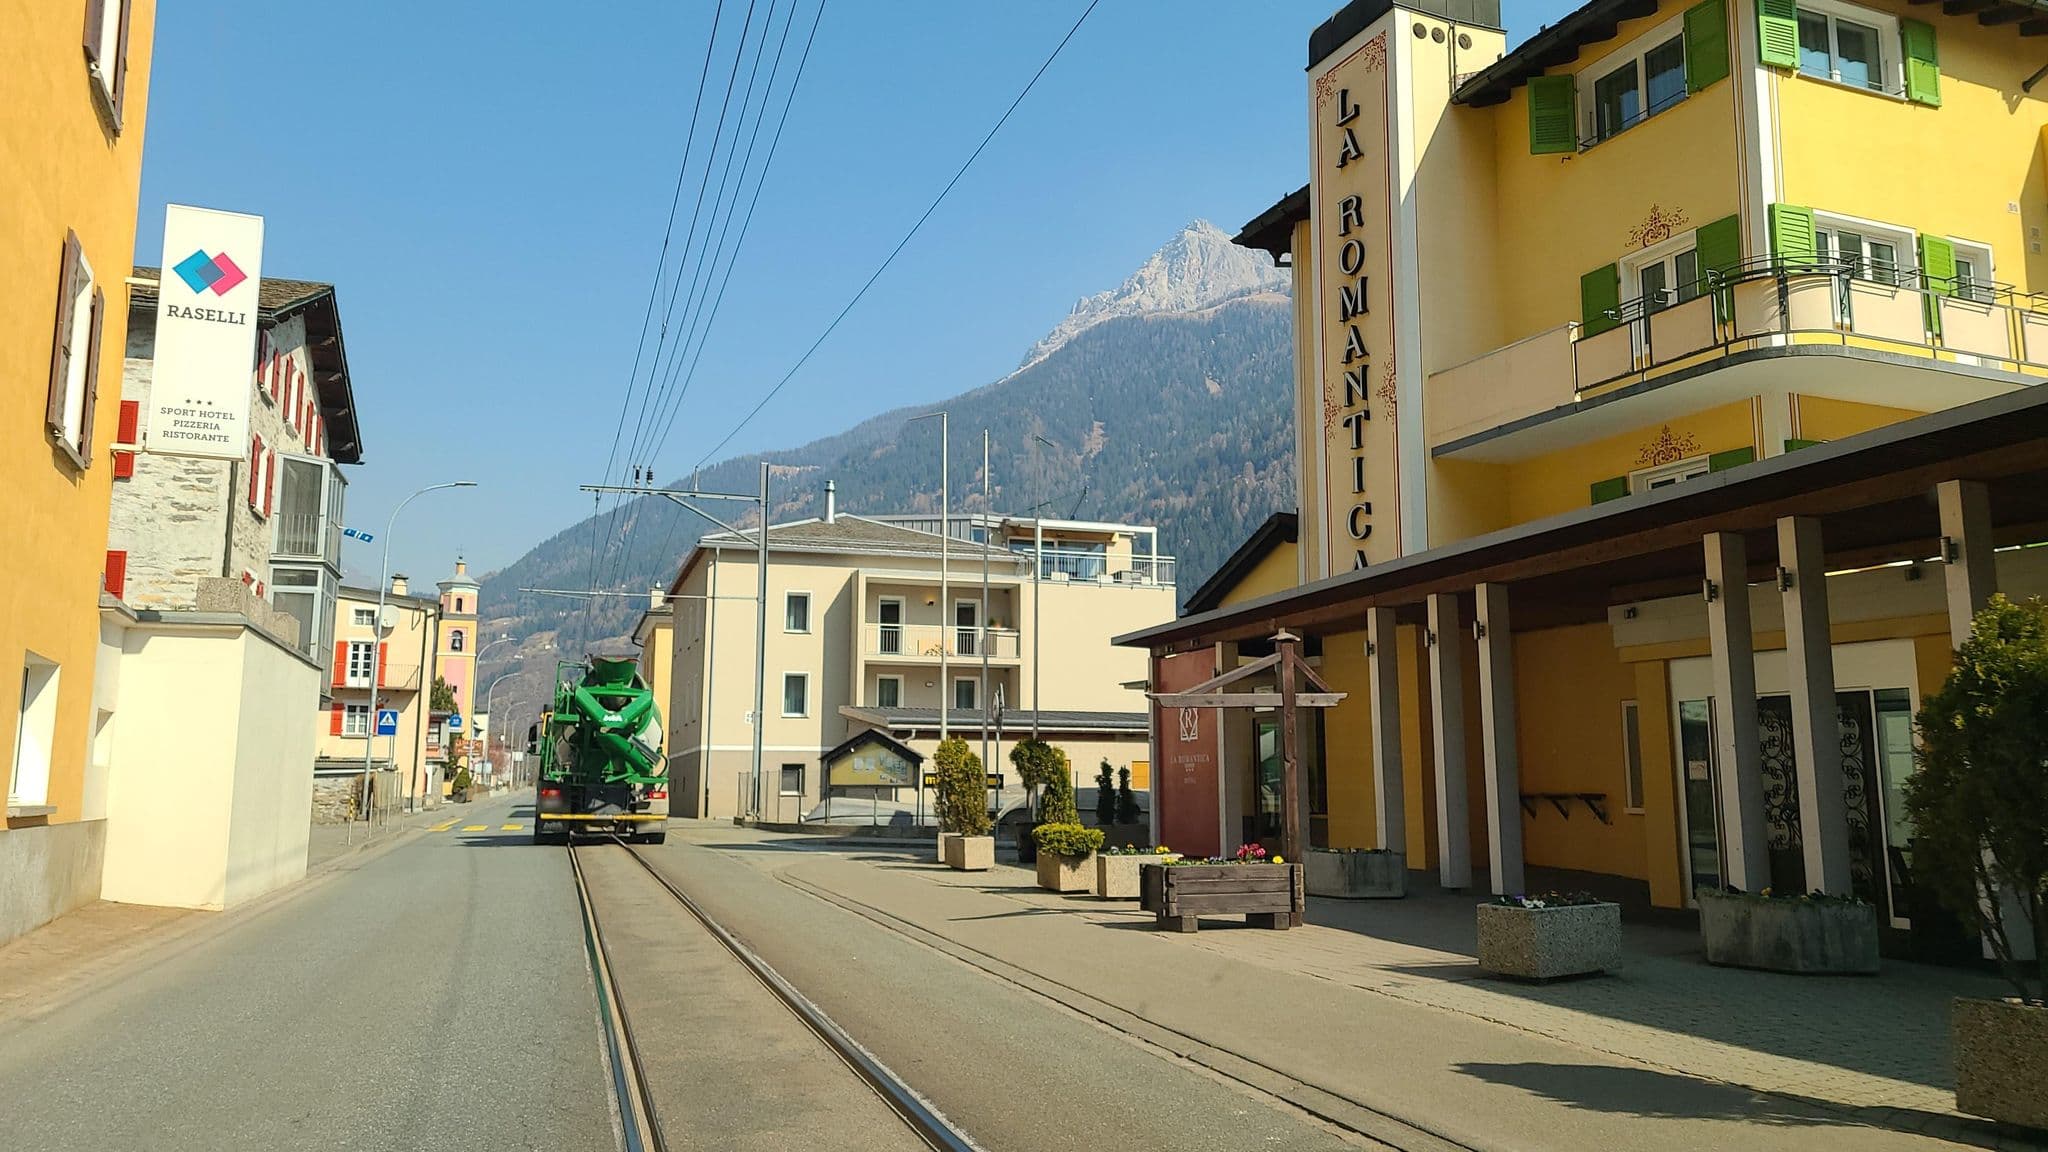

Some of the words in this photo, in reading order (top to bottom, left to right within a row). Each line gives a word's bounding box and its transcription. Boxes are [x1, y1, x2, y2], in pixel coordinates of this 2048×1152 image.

[1335, 88, 1364, 169] LA
[167, 305, 246, 325] RASELLI
[160, 407, 196, 417] SPORT
[199, 411, 235, 420] HOTEL
[173, 420, 220, 430] PIZZERIA
[162, 431, 230, 442] RISTORANTE
